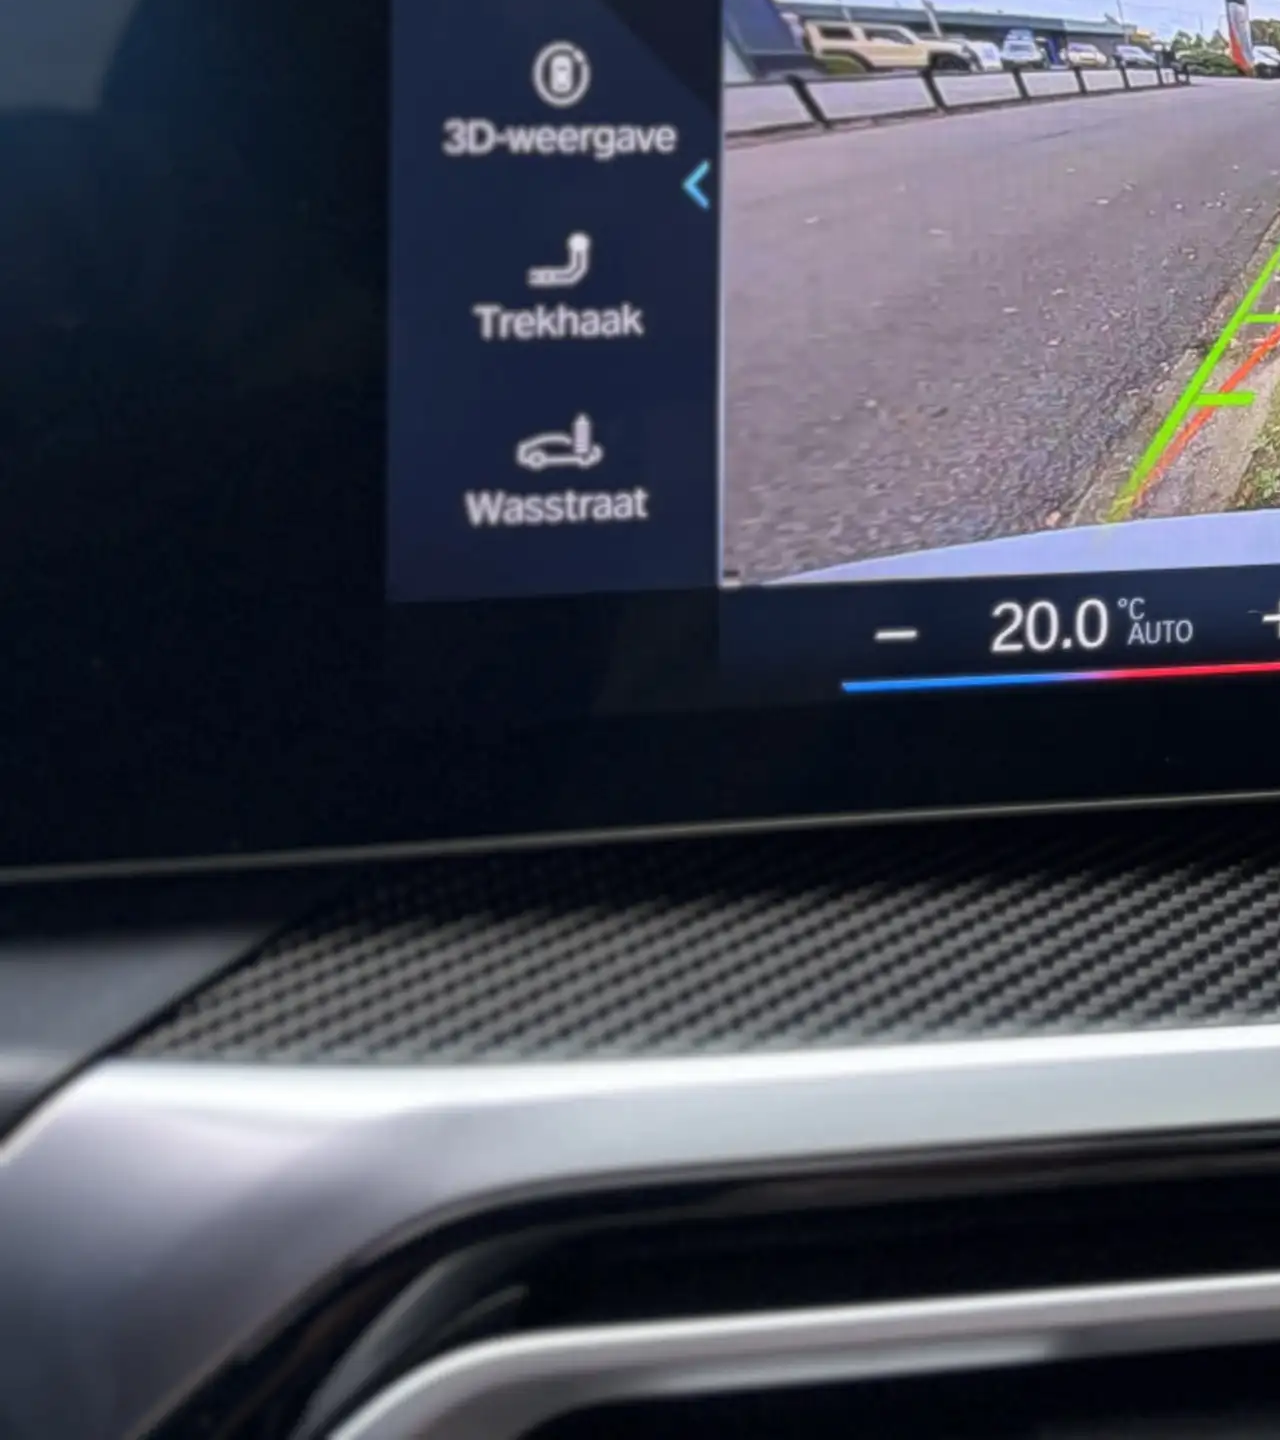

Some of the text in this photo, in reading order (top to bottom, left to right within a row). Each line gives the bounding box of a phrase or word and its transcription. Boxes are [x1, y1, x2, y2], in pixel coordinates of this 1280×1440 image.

[442, 118, 679, 162] 3D-weergave
[473, 303, 645, 341] Trekhaak
[465, 487, 650, 527] Wasstraat
[990, 597, 1110, 654] 20.0
[1127, 620, 1194, 645] AUTO
